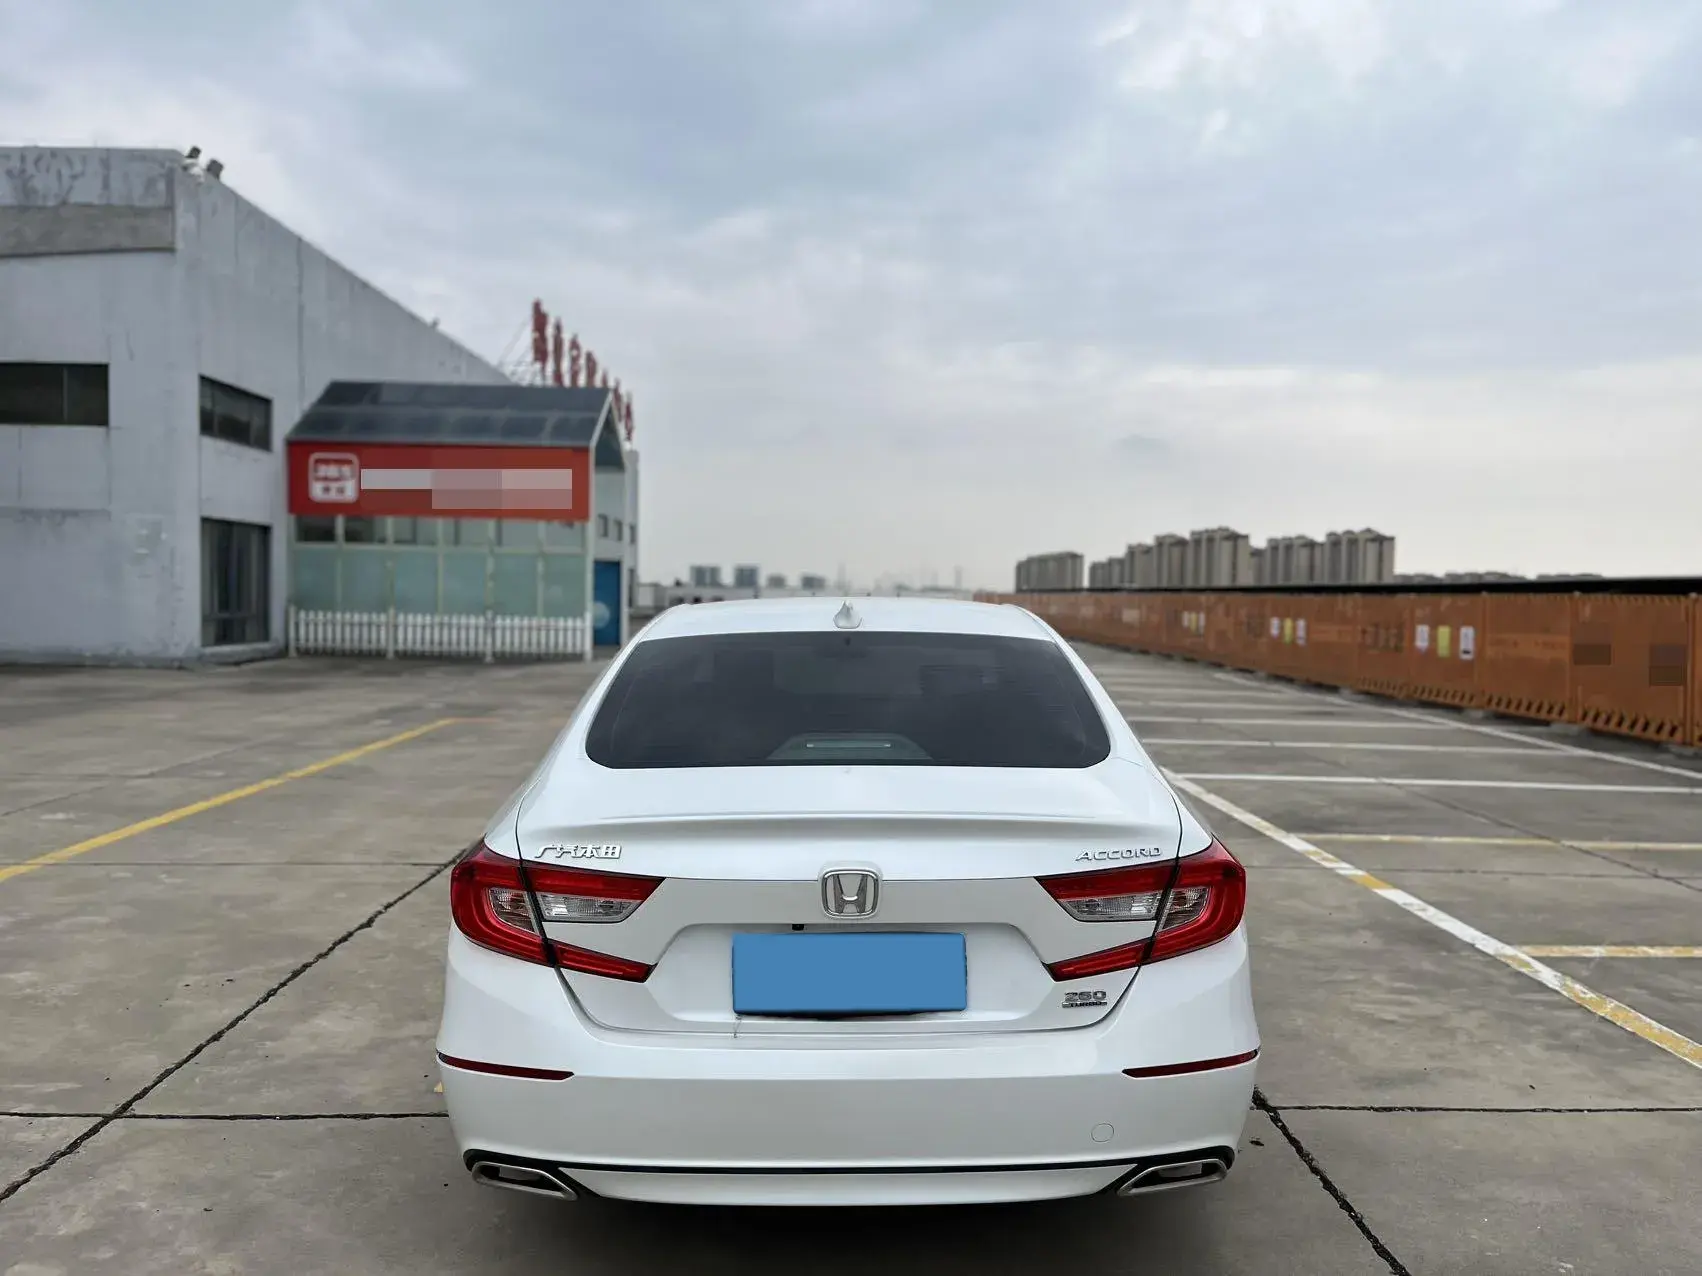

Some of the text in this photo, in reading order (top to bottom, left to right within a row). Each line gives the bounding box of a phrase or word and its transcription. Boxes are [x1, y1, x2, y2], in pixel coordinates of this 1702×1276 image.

[534, 844, 622, 859] 广汽本田
[1075, 847, 1161, 862] ACCORD
[1064, 991, 1107, 1002] 260
